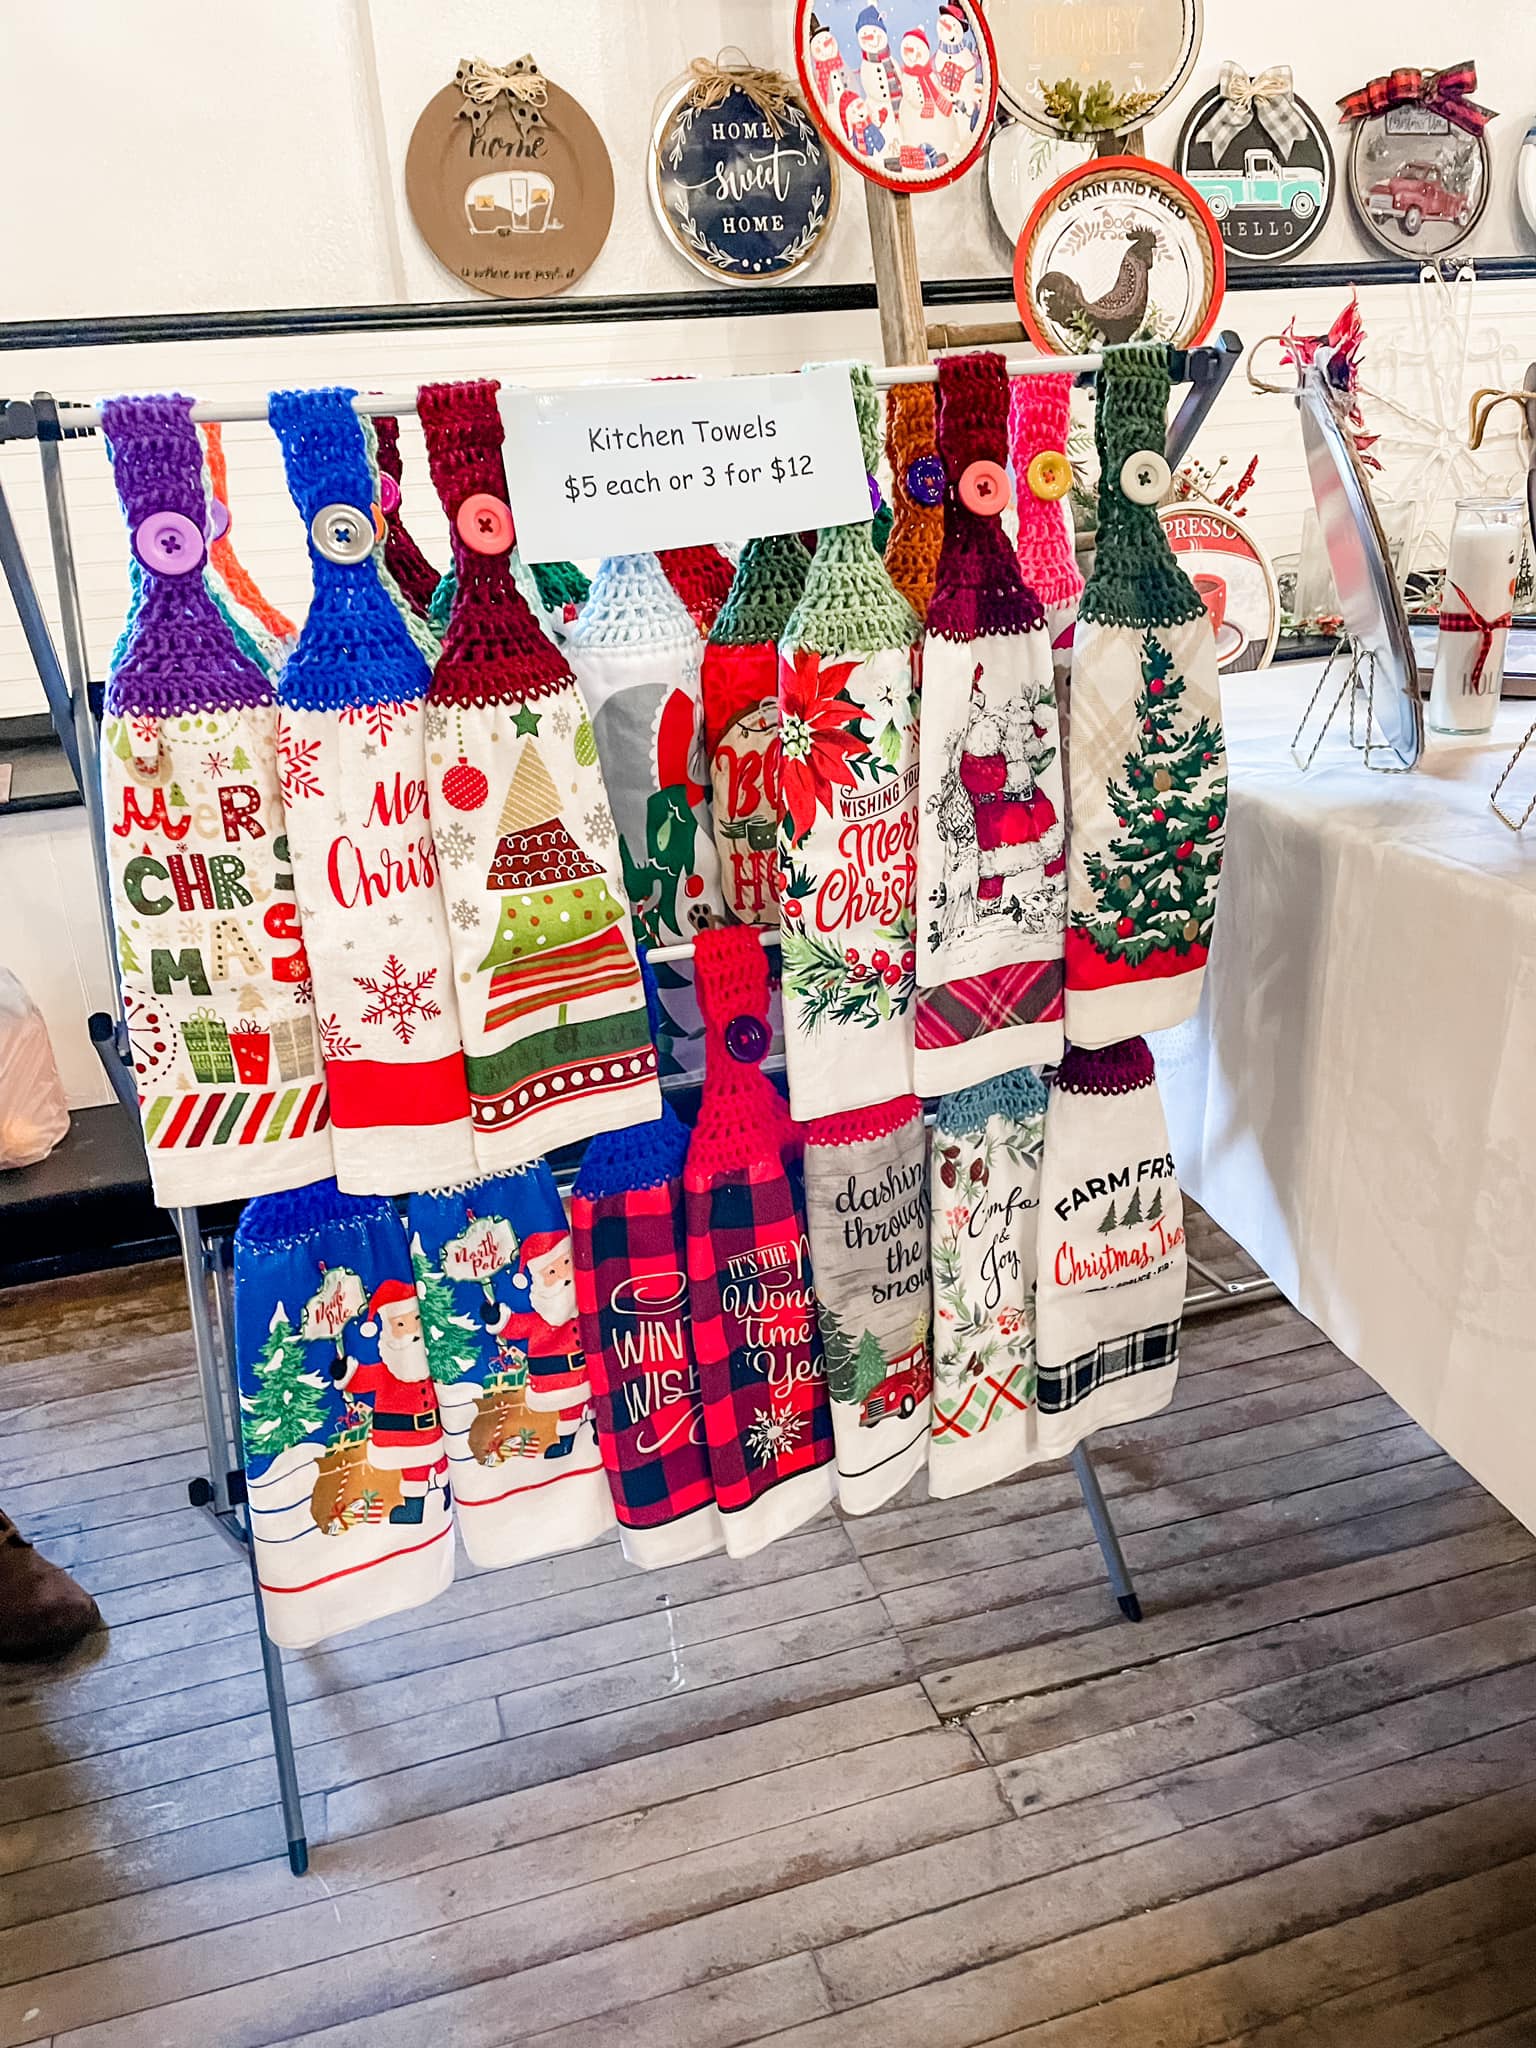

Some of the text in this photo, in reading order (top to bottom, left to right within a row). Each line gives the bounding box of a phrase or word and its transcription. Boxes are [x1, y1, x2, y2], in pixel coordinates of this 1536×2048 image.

[468, 133, 548, 159] home
[711, 122, 774, 140] HOME
[673, 142, 807, 202] sweet
[1058, 181, 1187, 220] GRAIN AND FEED
[721, 215, 784, 234] HOME
[1221, 221, 1293, 236] HELLO
[588, 415, 777, 453] Kitchen Towels
[564, 455, 814, 503] $5 each or 3 for $12
[1163, 518, 1238, 539] PRESSO
[840, 782, 900, 819] WISHING
[835, 1163, 923, 1213] dashin
[1055, 1166, 1130, 1221] FARM
[728, 1254, 758, 1279] IT'S
[758, 1245, 791, 1269] THE
[886, 1240, 922, 1274] the
[981, 1233, 1021, 1309] Joy
[612, 1315, 692, 1370] WIN
